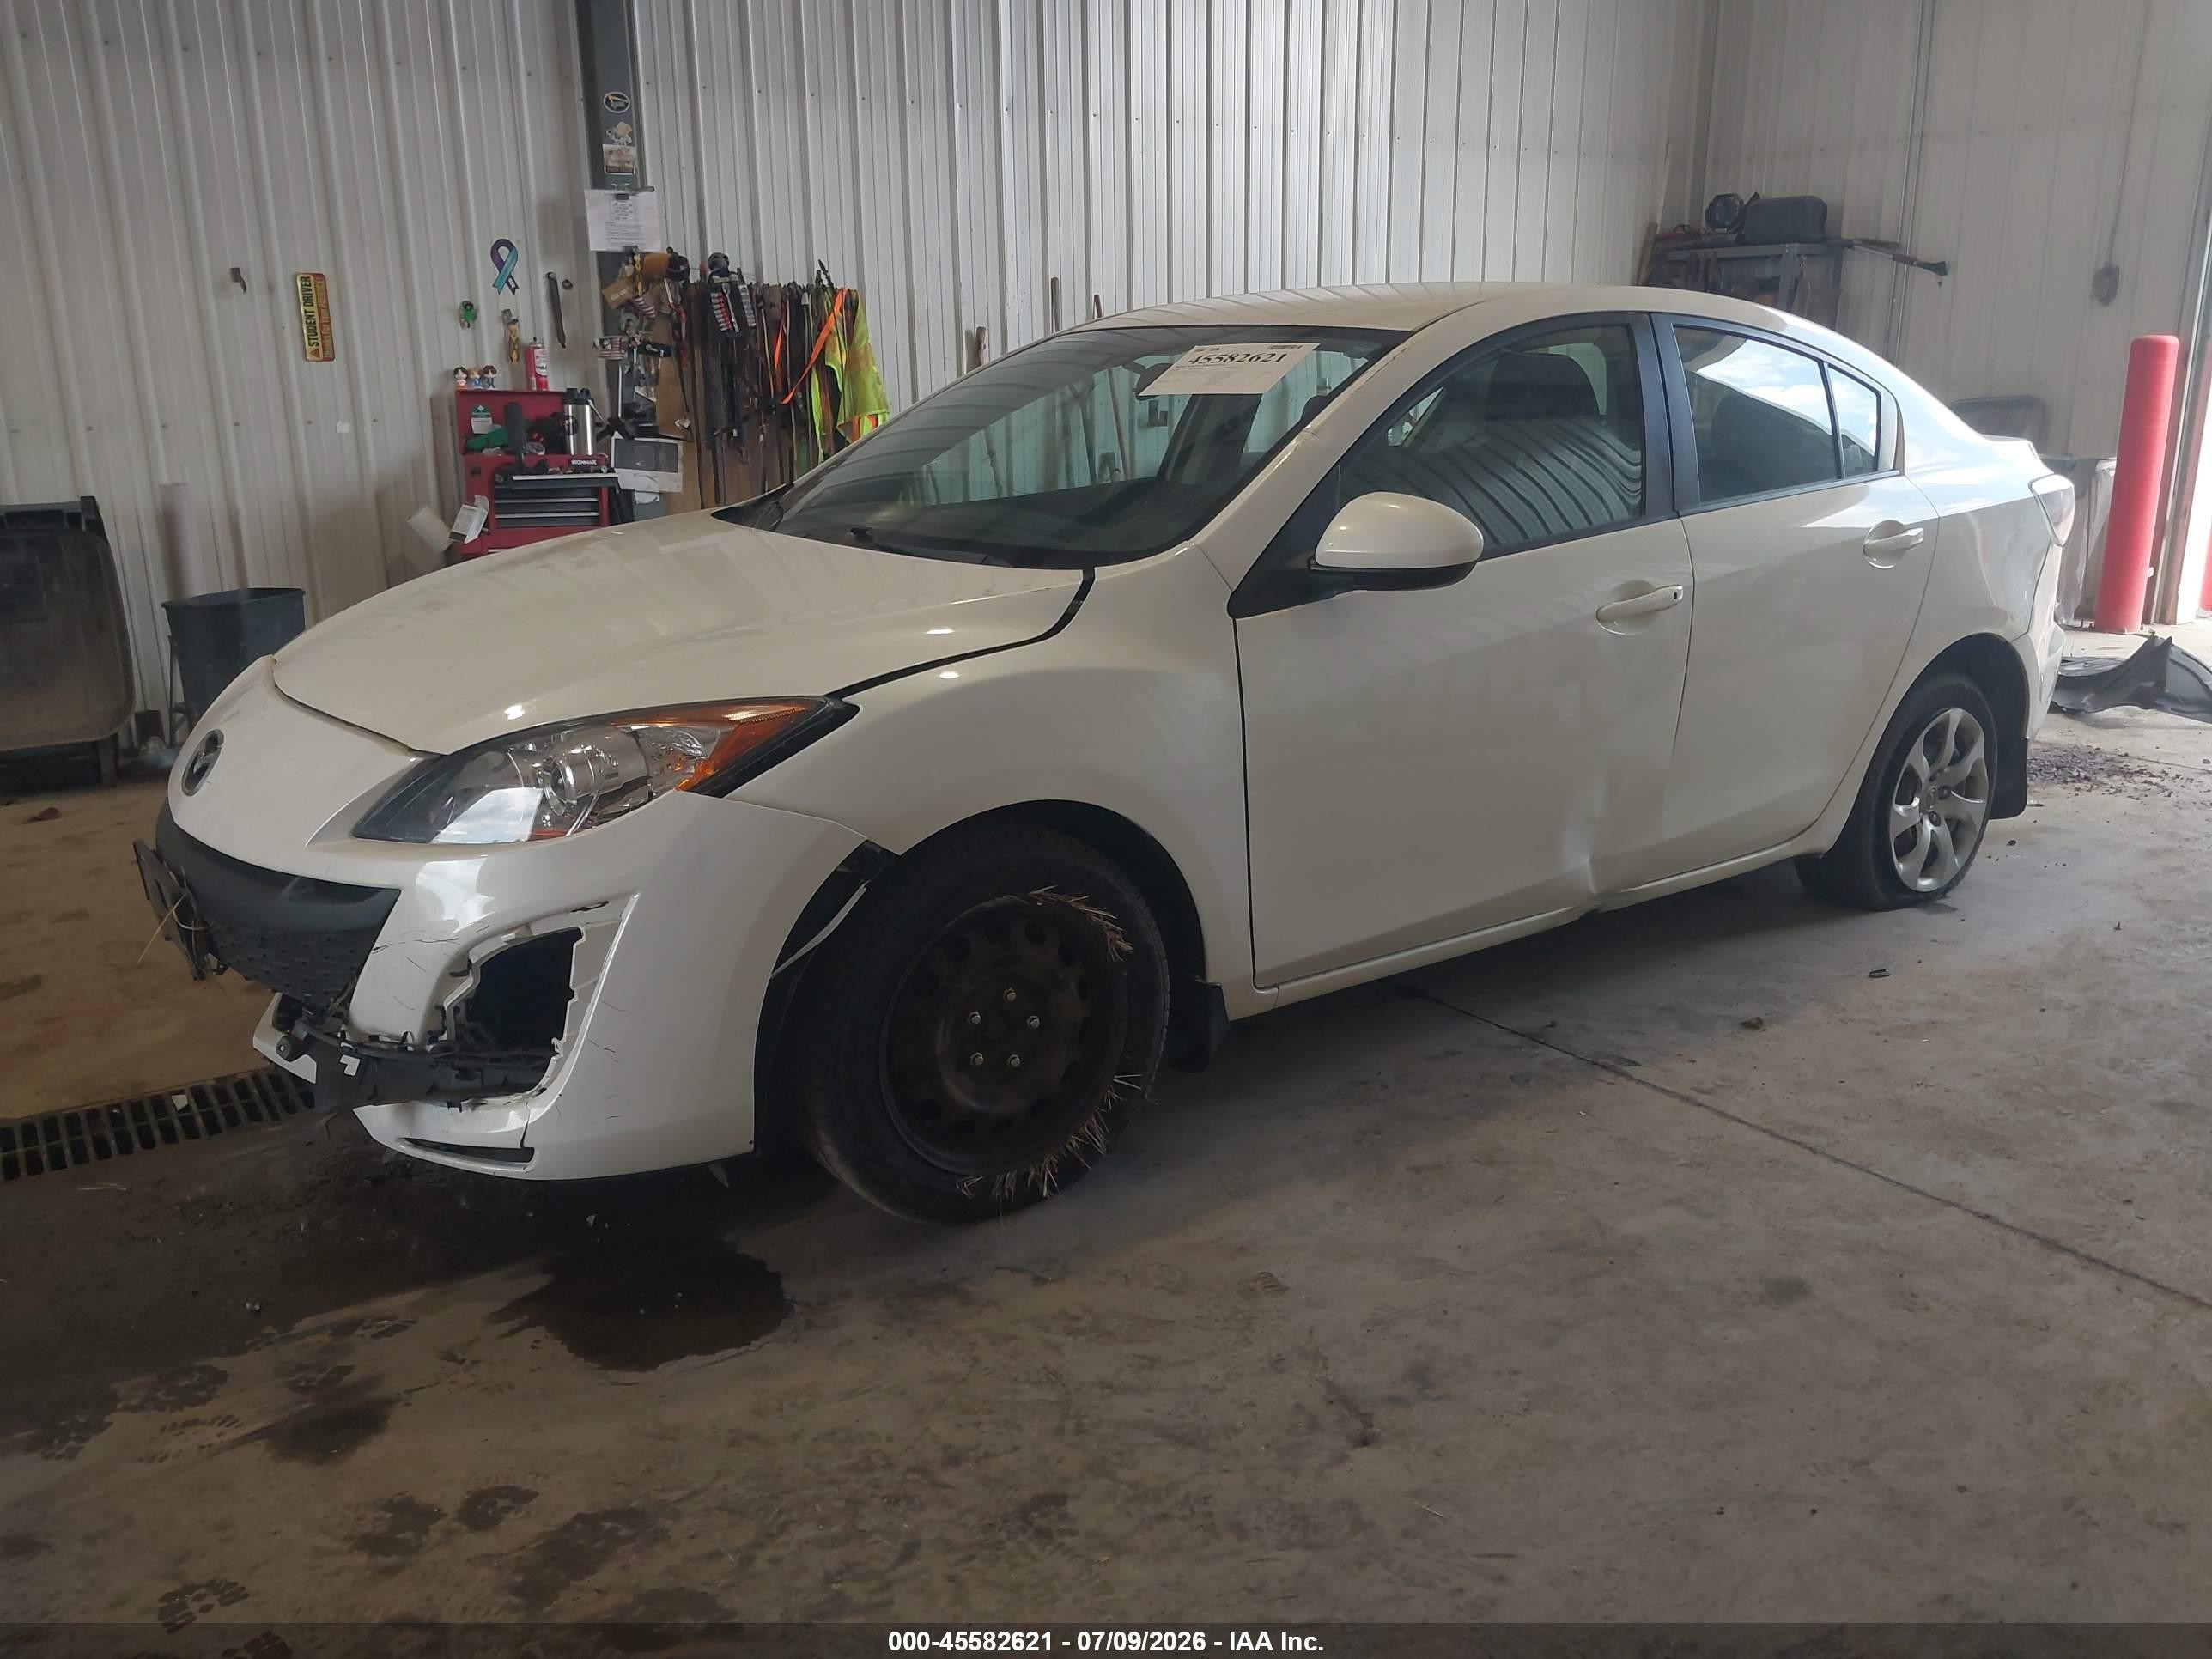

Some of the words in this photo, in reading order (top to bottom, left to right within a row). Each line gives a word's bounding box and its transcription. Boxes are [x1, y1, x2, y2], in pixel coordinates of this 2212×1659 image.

[300, 276, 314, 307] DRIVER
[304, 309, 319, 347] STUDENT
[1188, 351, 1288, 365] 45582621
